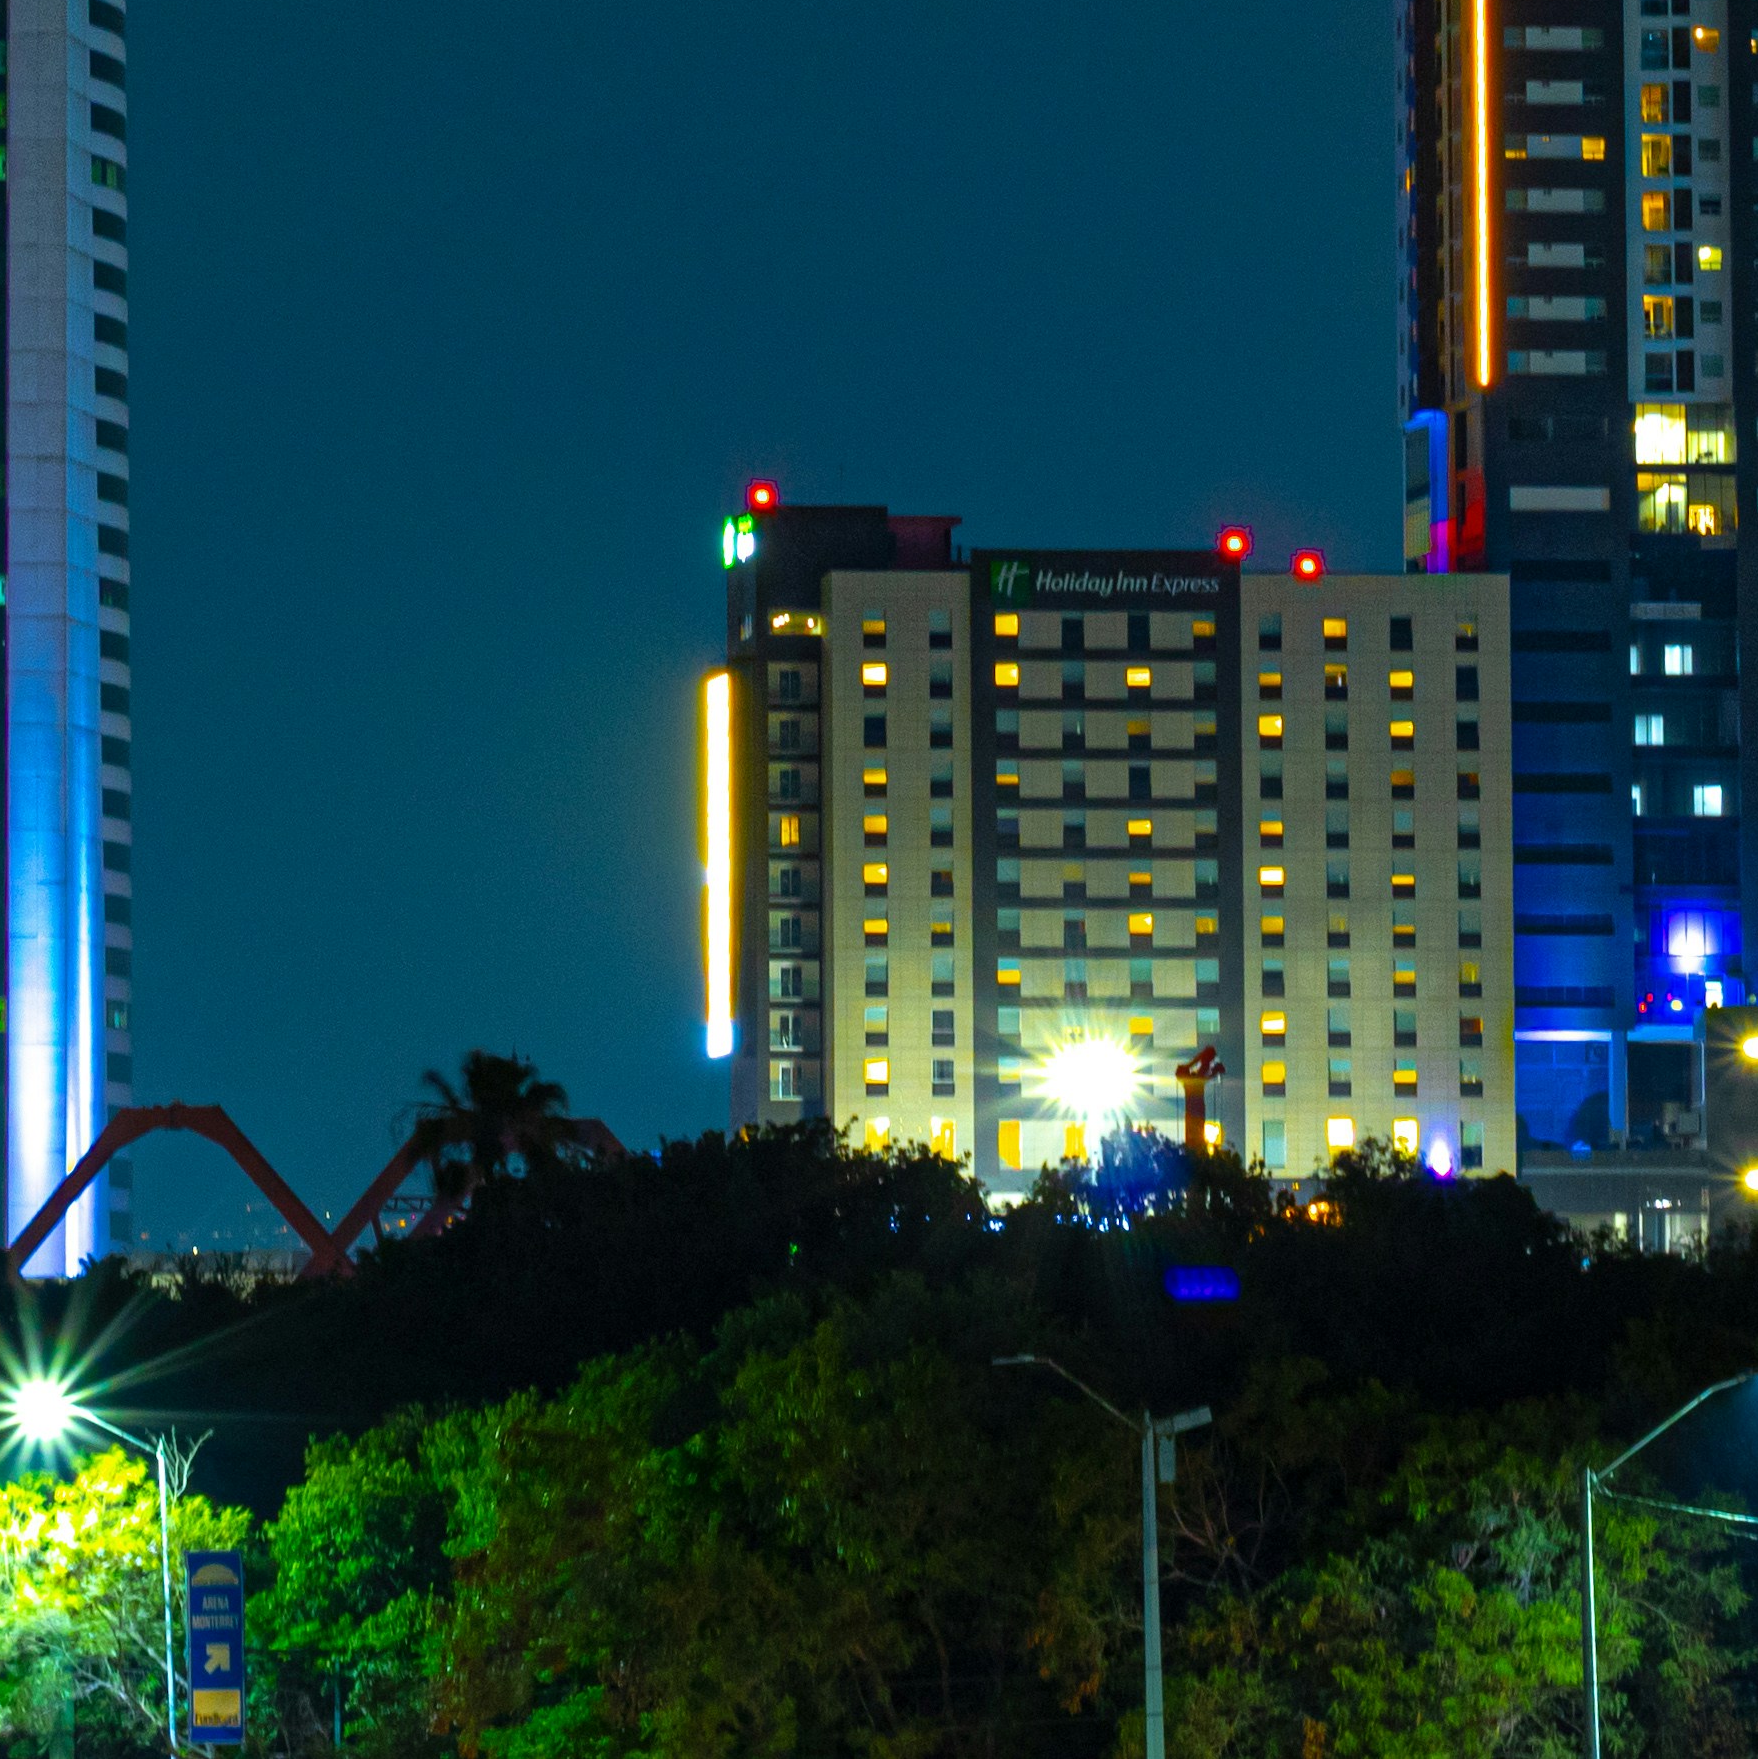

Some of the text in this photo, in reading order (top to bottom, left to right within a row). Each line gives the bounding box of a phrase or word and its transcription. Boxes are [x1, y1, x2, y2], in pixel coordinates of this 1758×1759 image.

[1036, 569, 1220, 597] Holiday Inn Express
